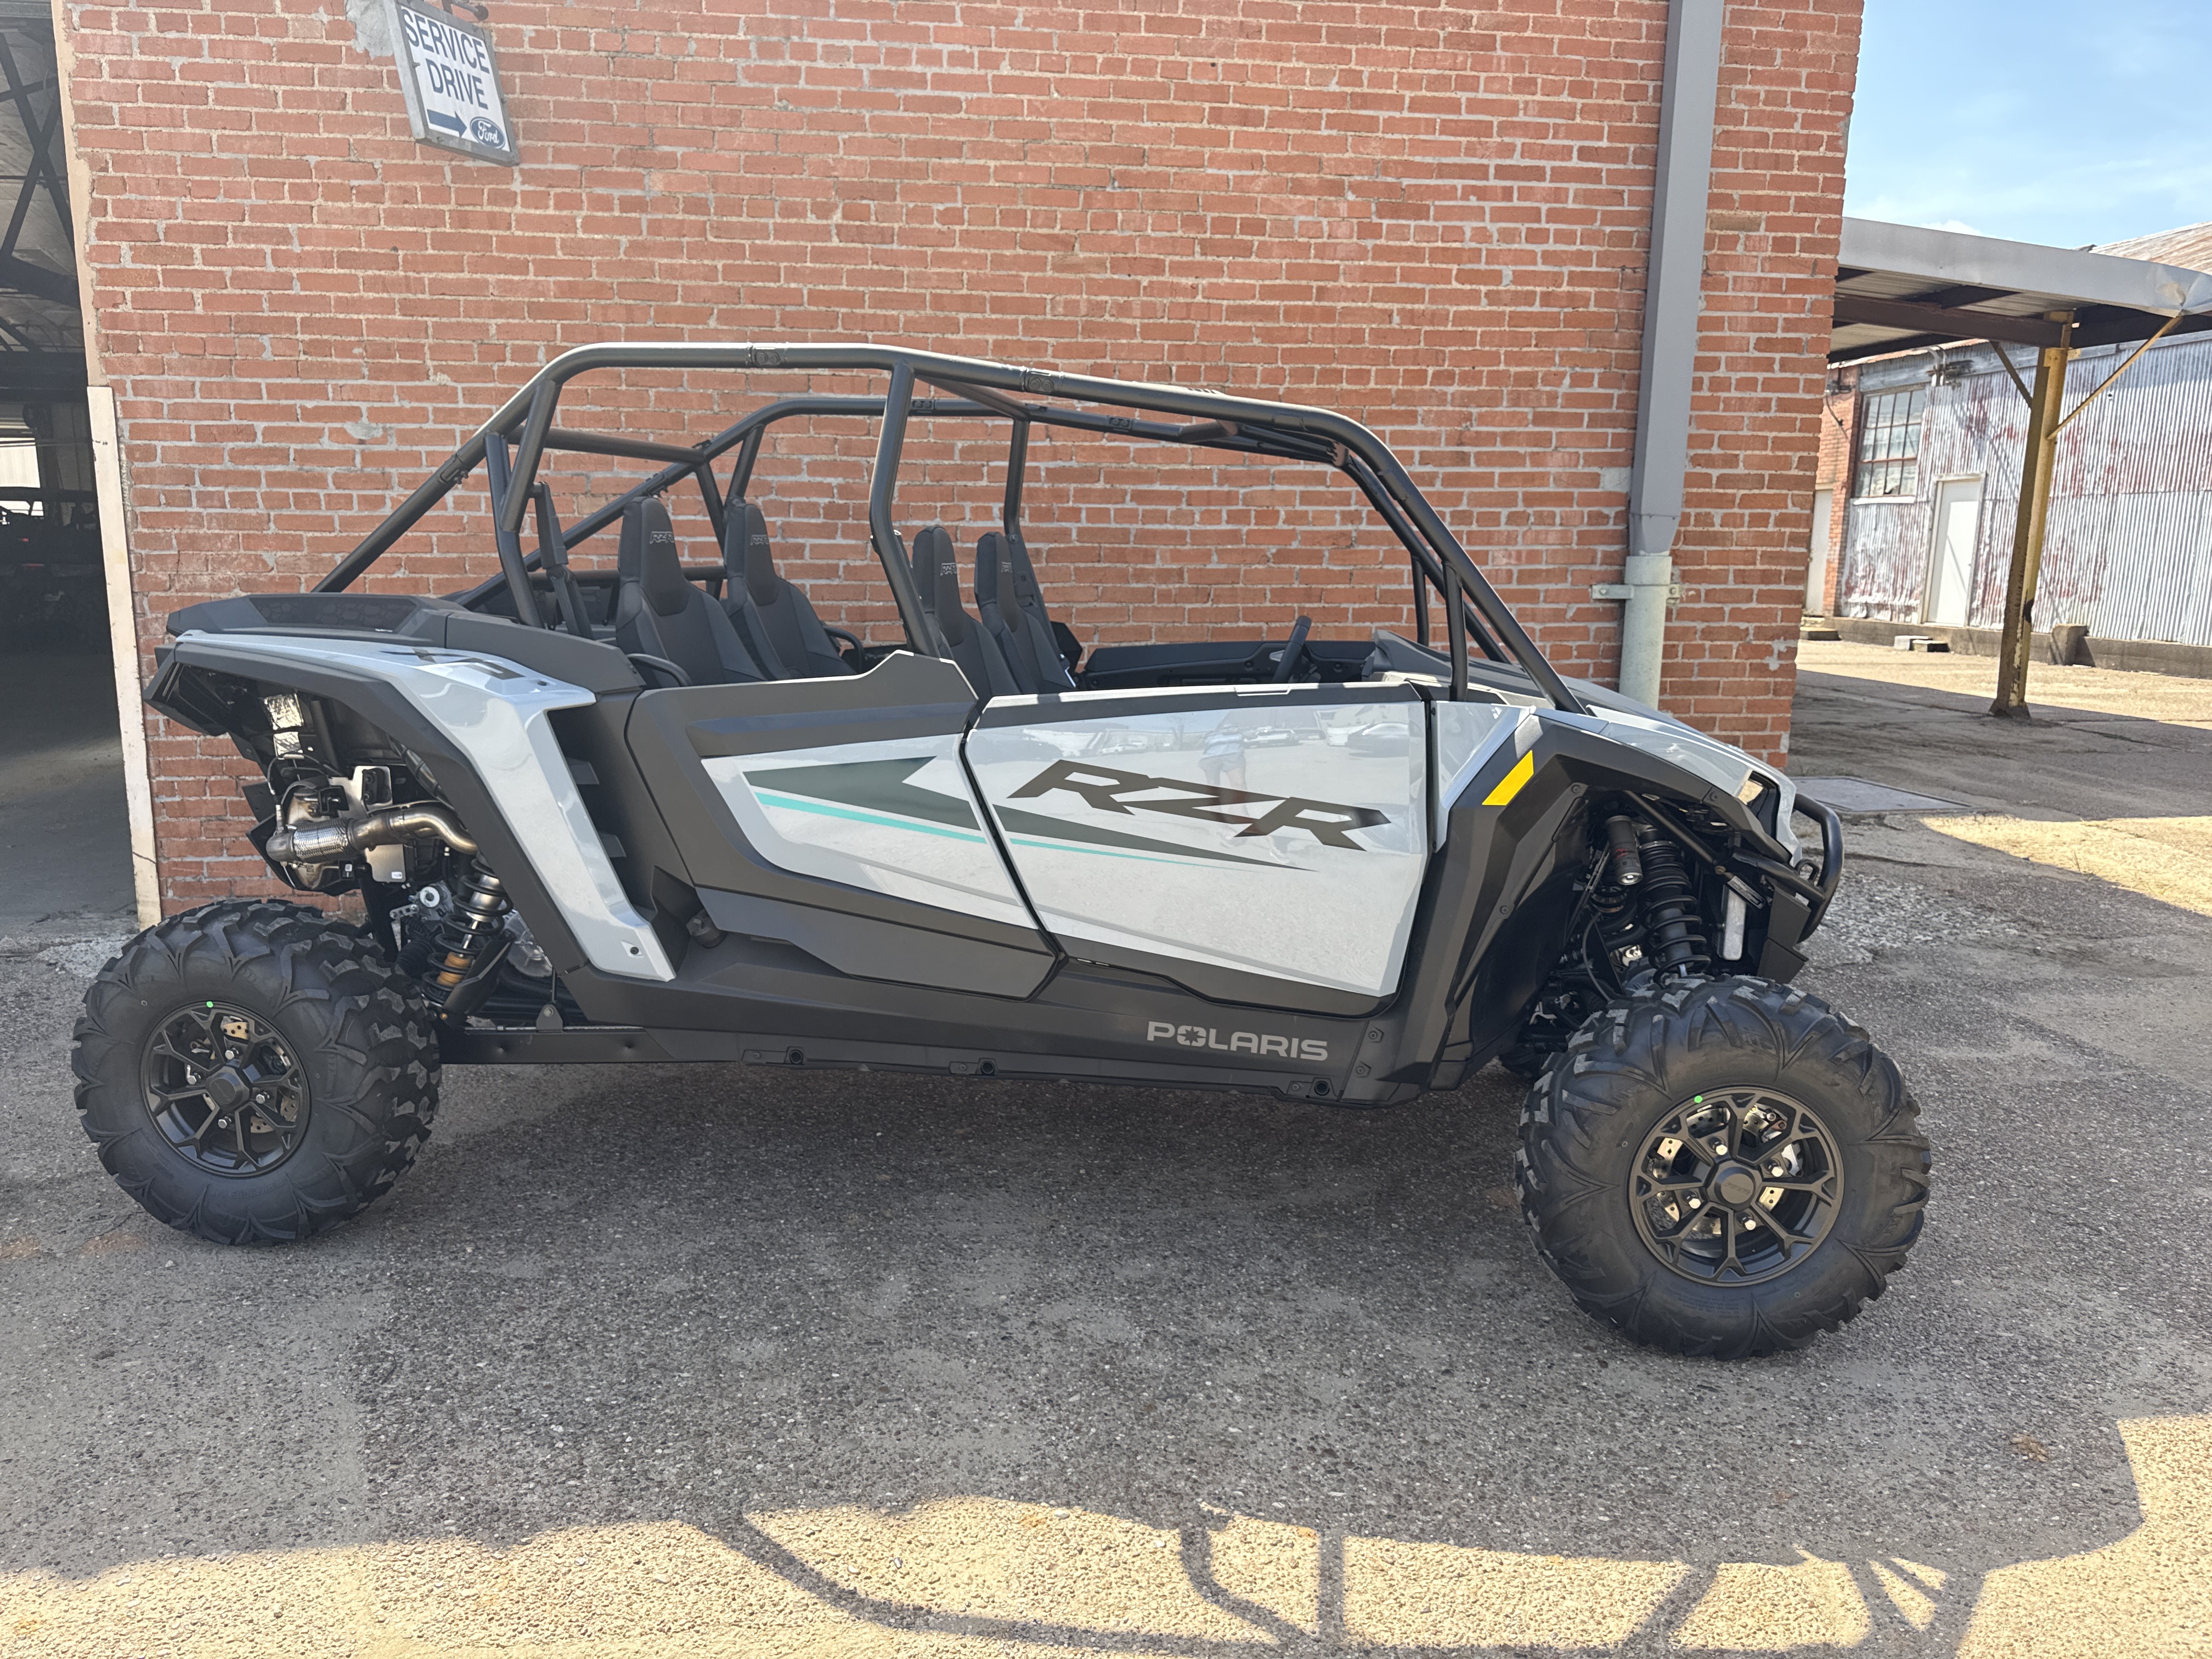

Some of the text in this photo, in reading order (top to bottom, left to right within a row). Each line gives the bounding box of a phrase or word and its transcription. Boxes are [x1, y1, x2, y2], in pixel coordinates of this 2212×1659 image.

[401, 9, 490, 74] SERVICE
[425, 58, 489, 110] DRIVE
[477, 120, 500, 144] Ford
[1006, 759, 1391, 851] RZR
[1147, 1020, 1328, 1062] POLARIS
